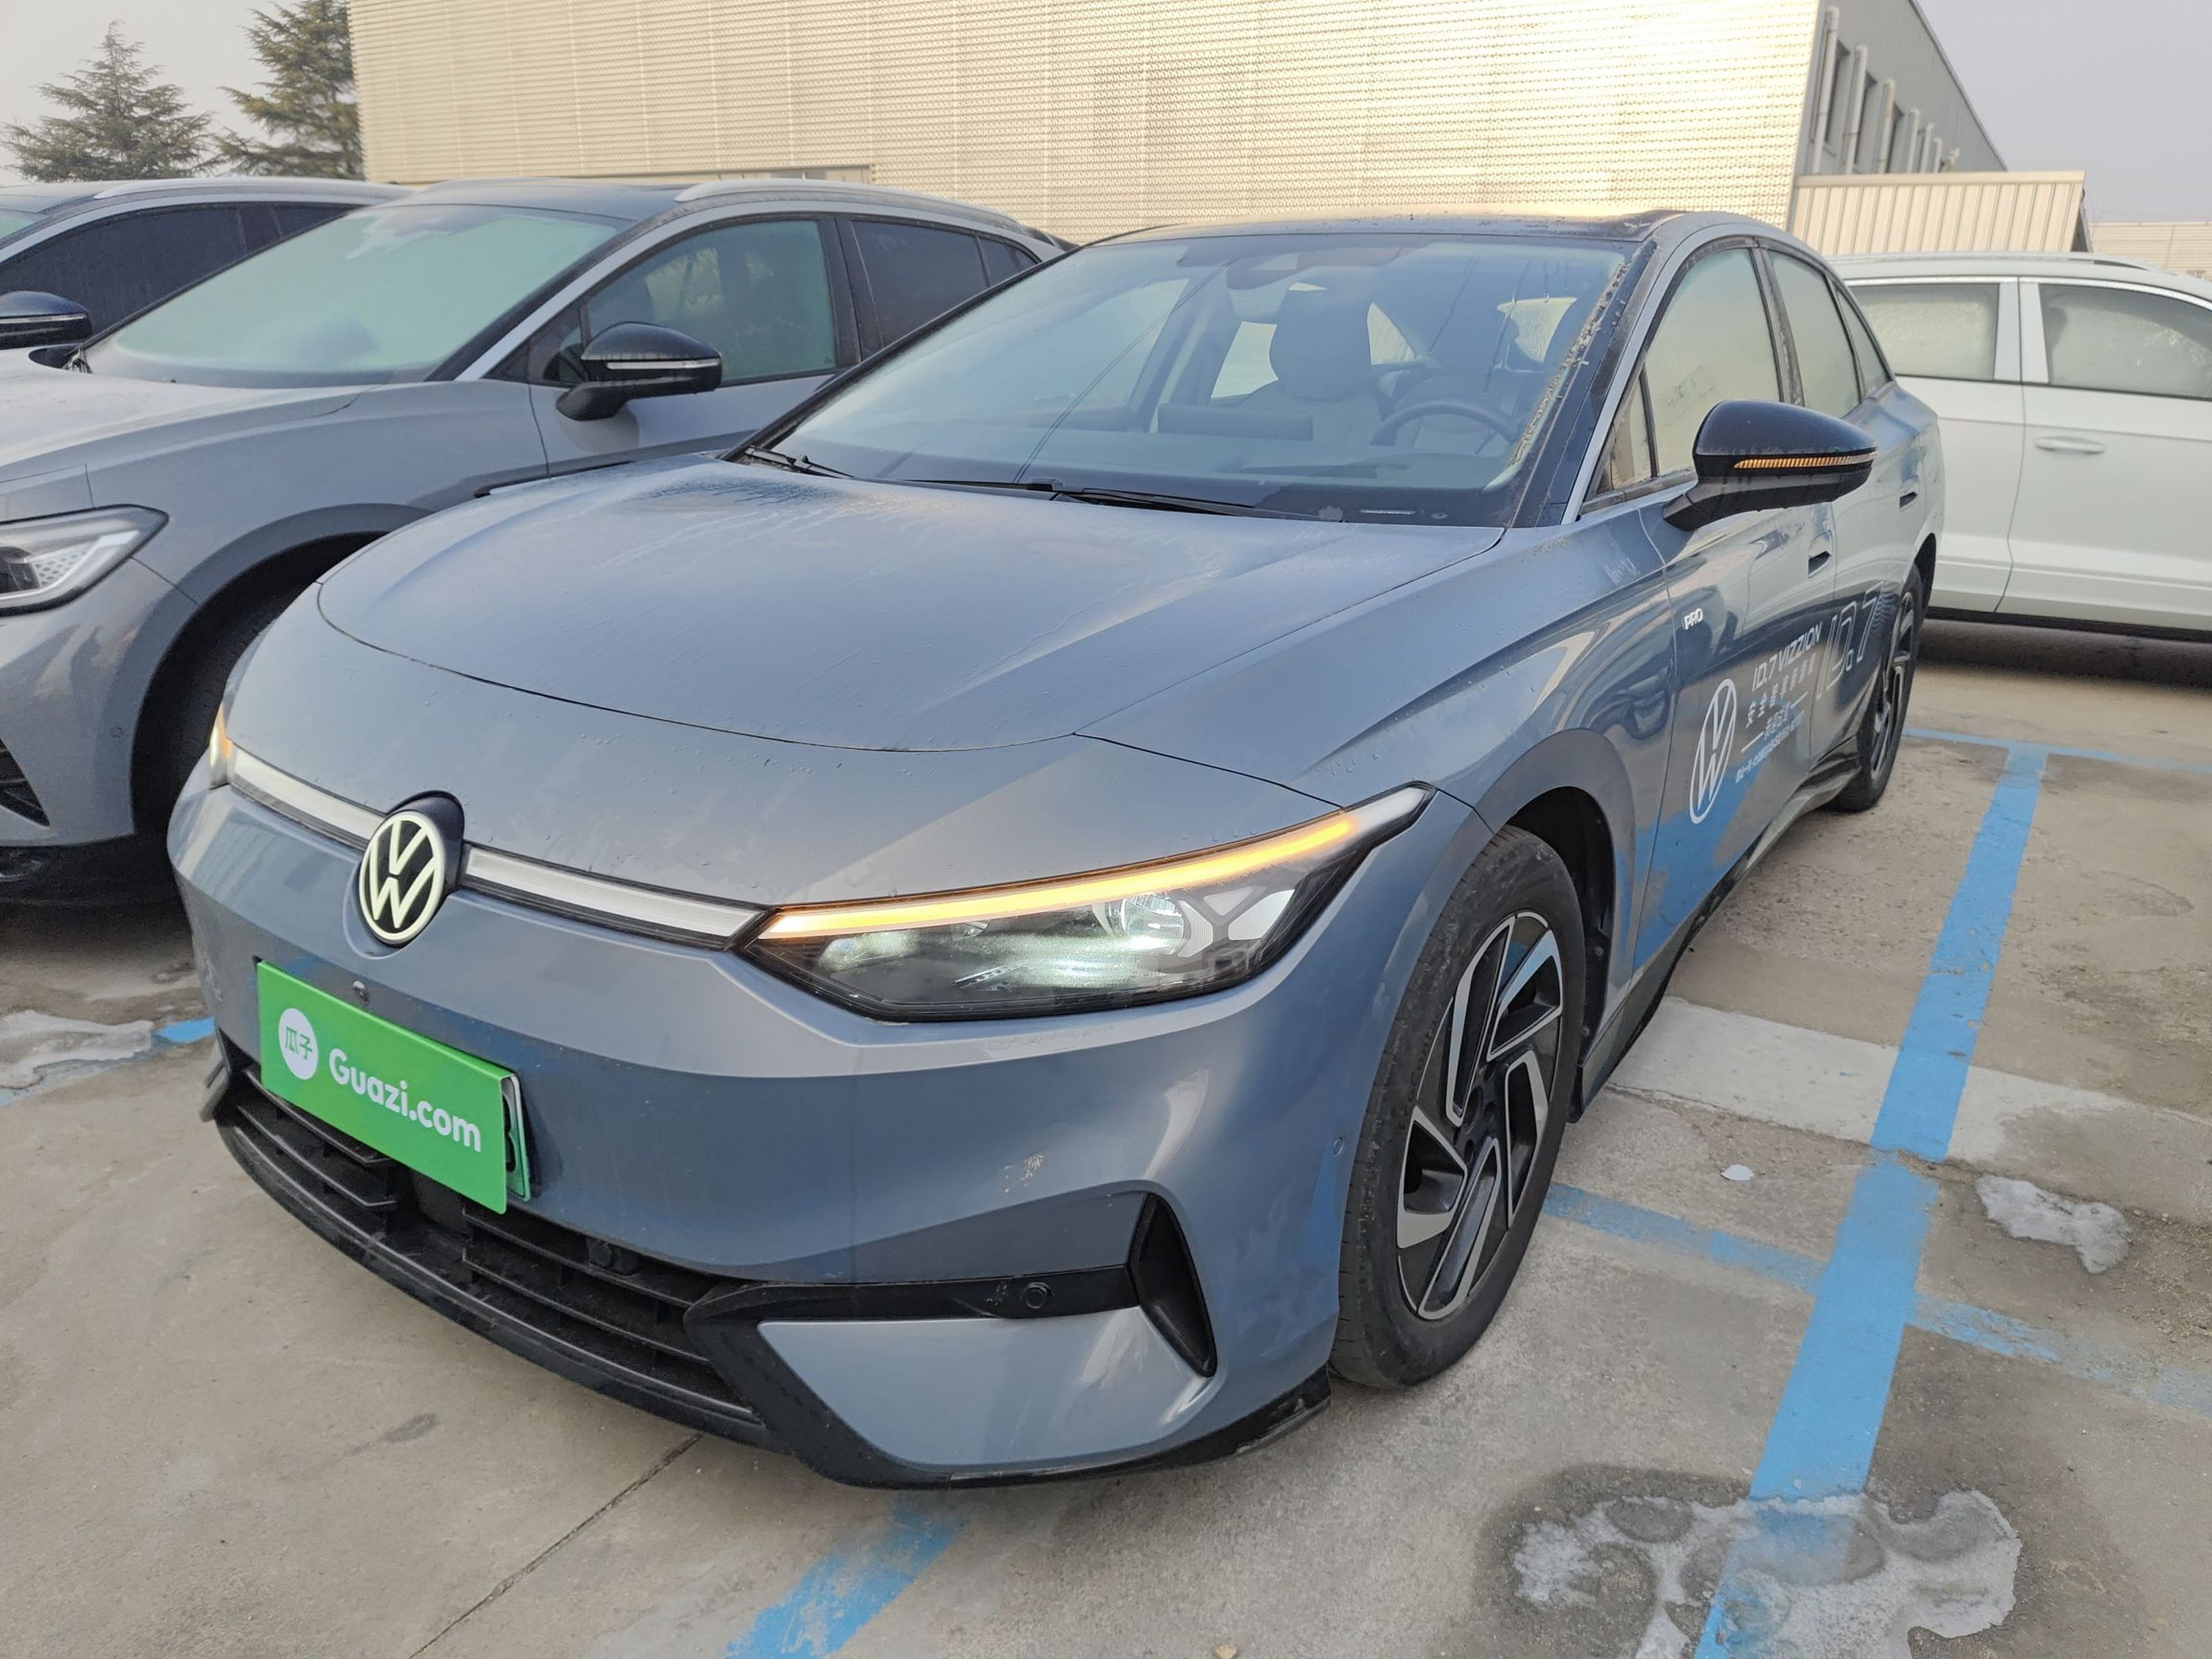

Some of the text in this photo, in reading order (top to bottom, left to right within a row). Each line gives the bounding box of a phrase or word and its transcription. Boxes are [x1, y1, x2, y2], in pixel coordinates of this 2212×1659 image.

[1683, 608, 1703, 631] PRO
[1752, 654, 1778, 691] ID.7
[1778, 621, 1823, 672] VIZZION
[285, 1025, 312, 1060] 瓜子
[329, 1048, 481, 1153] Guazi.com
